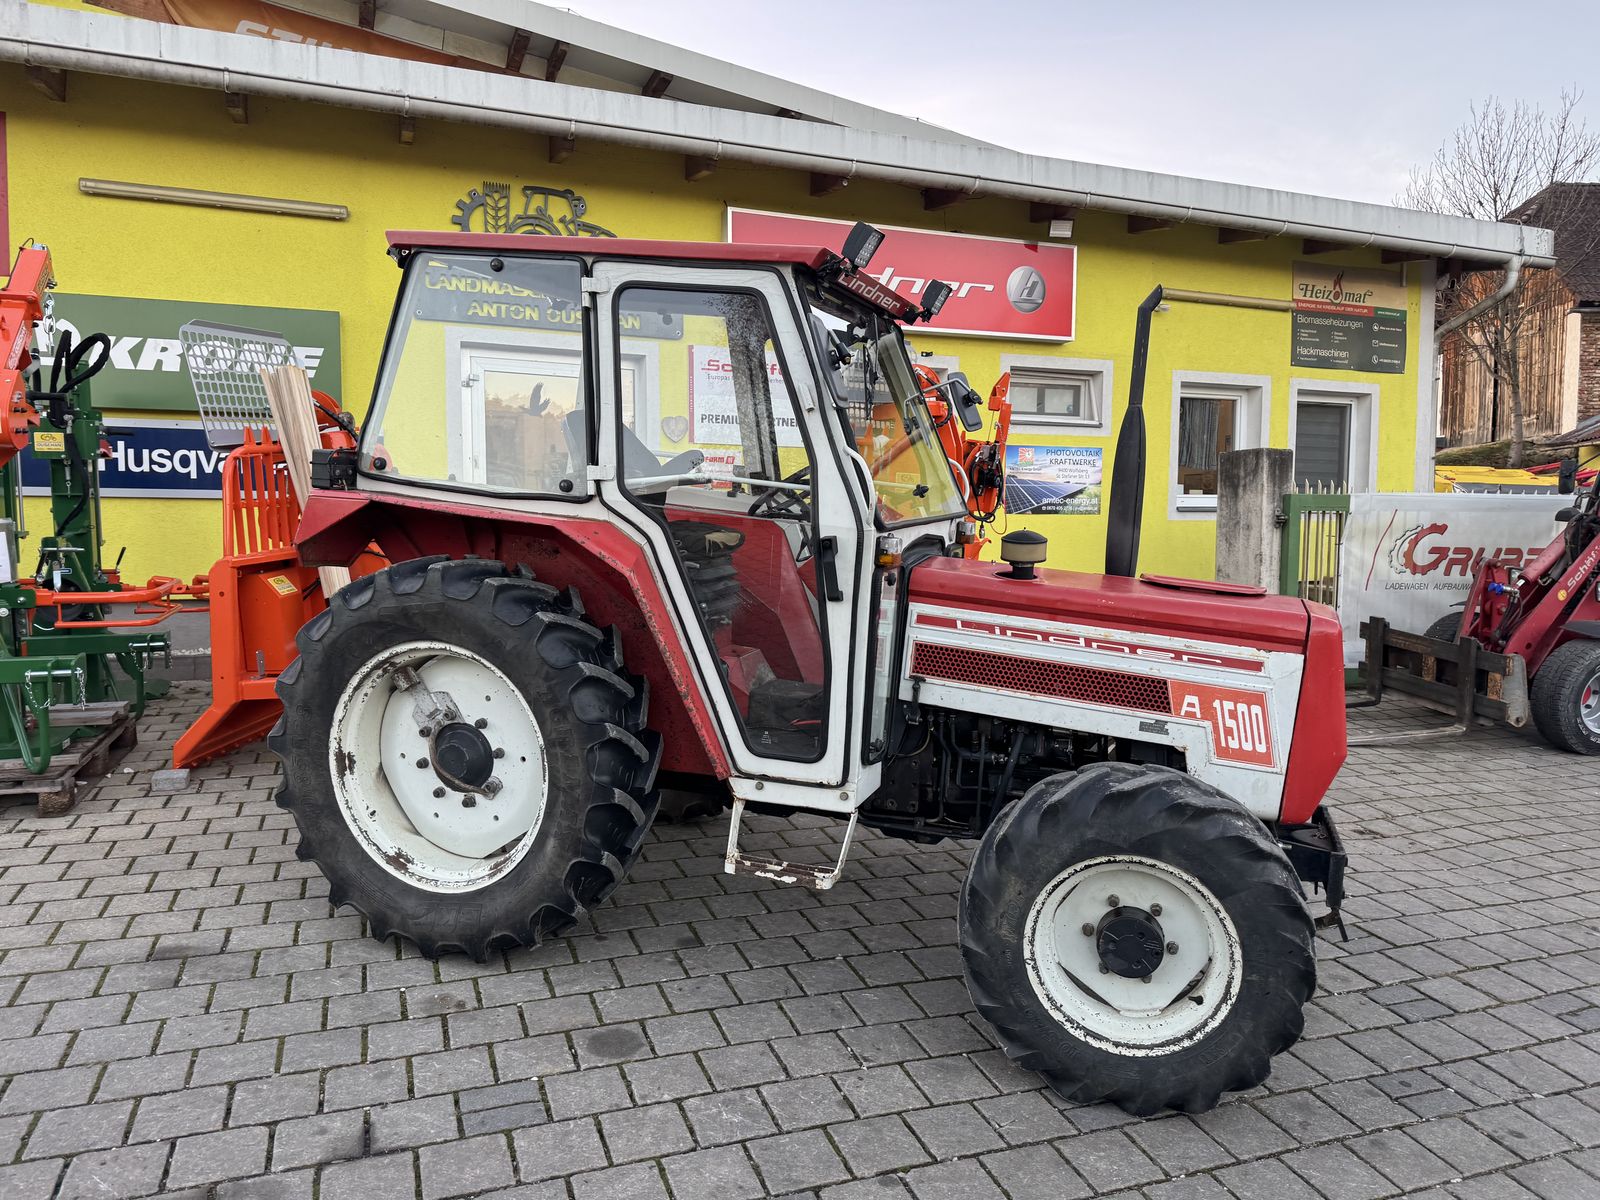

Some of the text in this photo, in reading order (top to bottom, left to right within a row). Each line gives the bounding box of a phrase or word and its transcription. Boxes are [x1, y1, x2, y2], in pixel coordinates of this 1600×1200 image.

[838, 272, 901, 310] Lindner
[467, 300, 539, 321] ANTON
[1297, 314, 1364, 329] Biomasseheizungen
[1297, 346, 1350, 358] Hackmaschinen
[1046, 448, 1100, 457] PHOTOVOLTAIK
[98, 441, 243, 480] Husqv
[1049, 458, 1097, 466] KRAFTWERKE
[1384, 582, 1429, 591] LADEWAGEN
[1180, 694, 1202, 718] A
[1212, 699, 1267, 754] 1500
